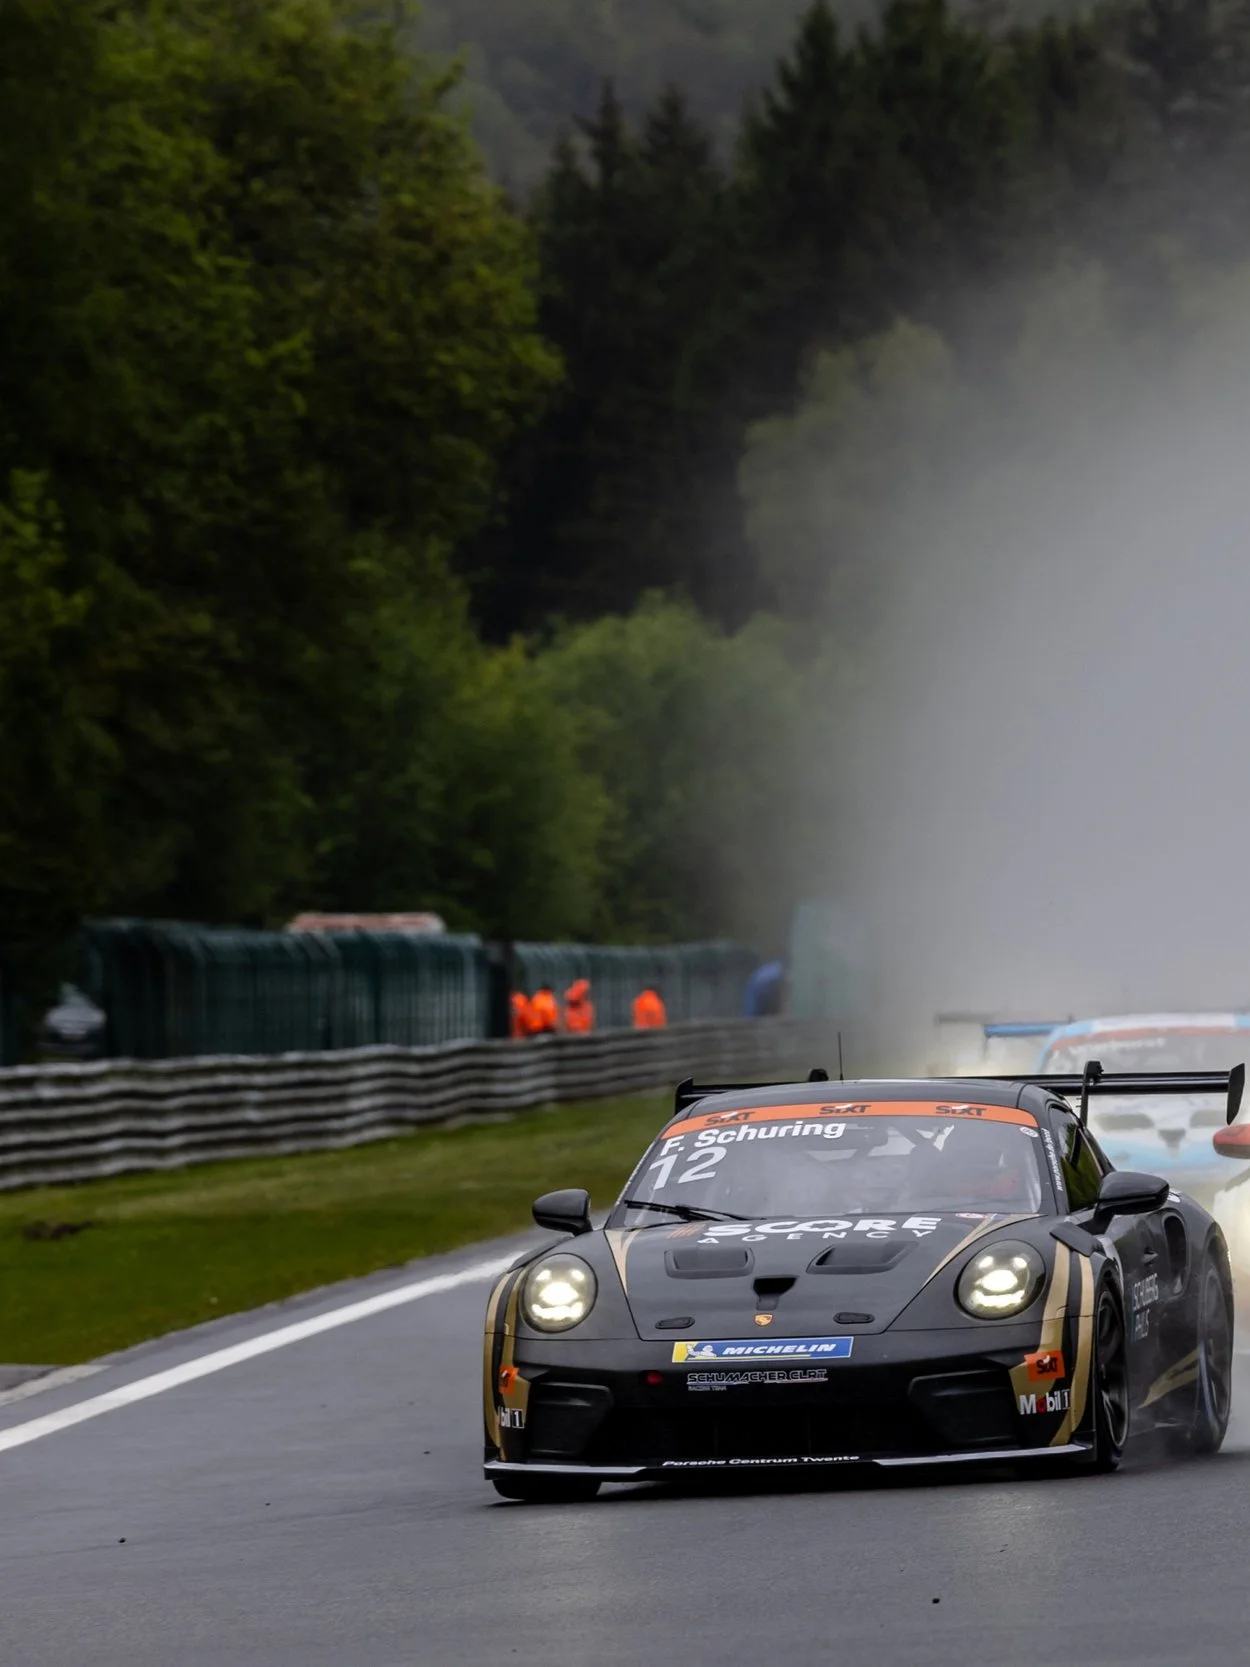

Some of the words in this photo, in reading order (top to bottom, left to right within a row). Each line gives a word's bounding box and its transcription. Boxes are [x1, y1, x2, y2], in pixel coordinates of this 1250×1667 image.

[660, 1135, 686, 1156] F.
[694, 1120, 847, 1149] Schuring
[649, 1146, 728, 1191] 12
[703, 1216, 942, 1237] SCORE
[697, 1229, 932, 1245] AGENCY
[722, 1343, 837, 1356] MICHELIN
[687, 1371, 787, 1384] SCHUMACHER
[788, 1368, 828, 1381] CLRT
[1019, 1390, 1061, 1415] Mobil
[662, 1459, 727, 1467] Porsche
[728, 1457, 799, 1465] Centrum
[800, 1454, 860, 1463] Twente
